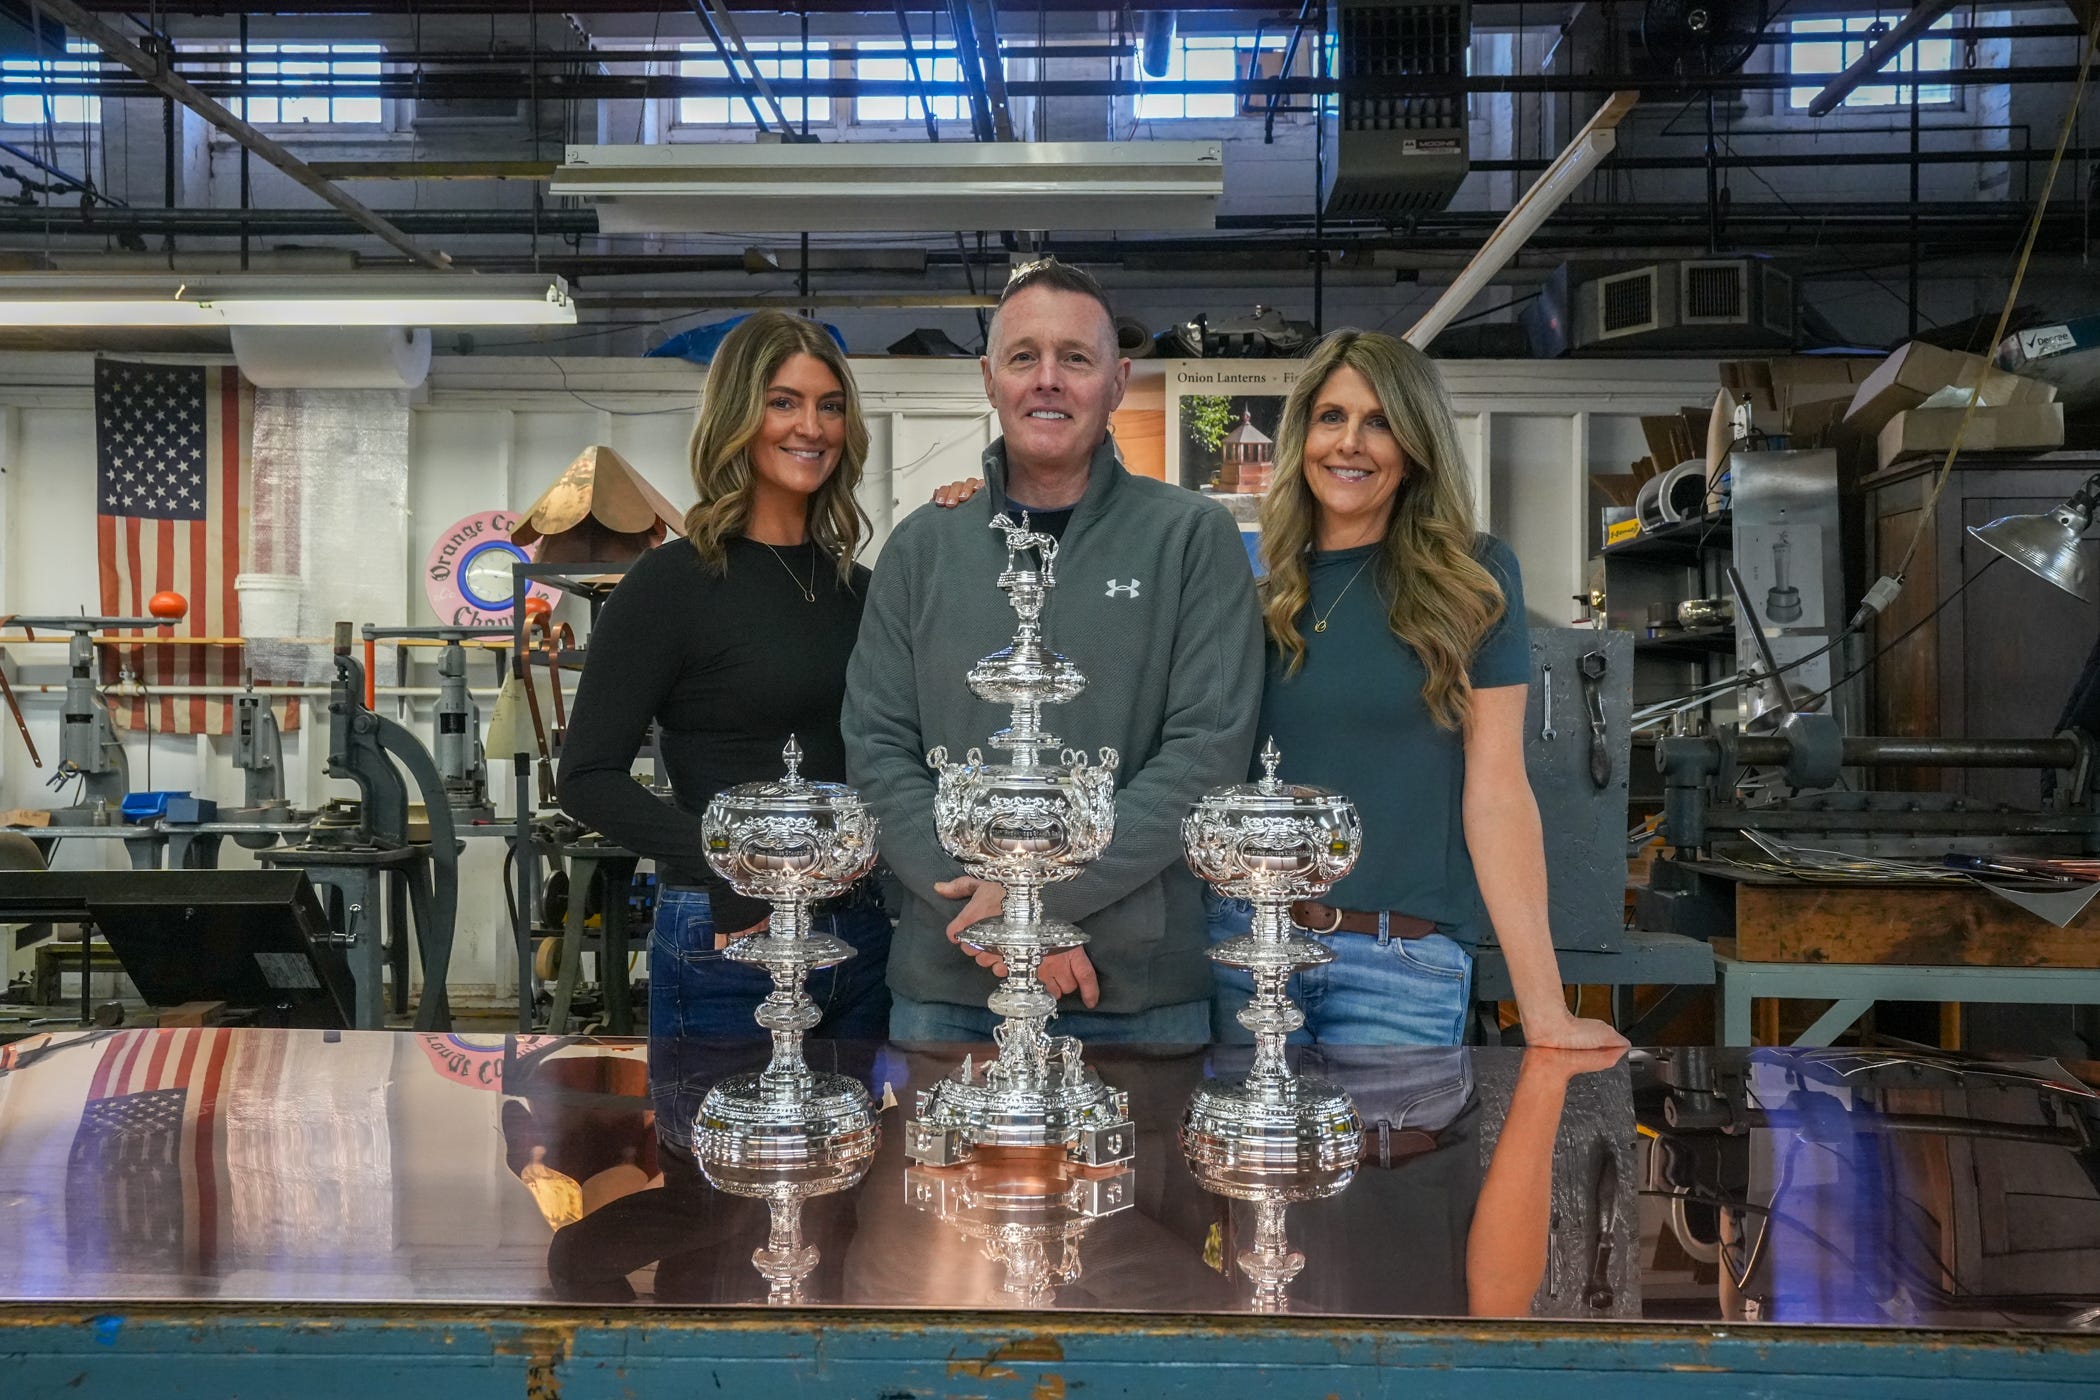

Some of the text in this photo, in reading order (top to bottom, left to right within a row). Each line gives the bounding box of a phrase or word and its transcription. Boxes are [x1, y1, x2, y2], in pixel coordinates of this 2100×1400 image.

[1177, 372, 1214, 383] Onion
[1217, 372, 1267, 383] Lanterns
[430, 520, 484, 582] Orange
